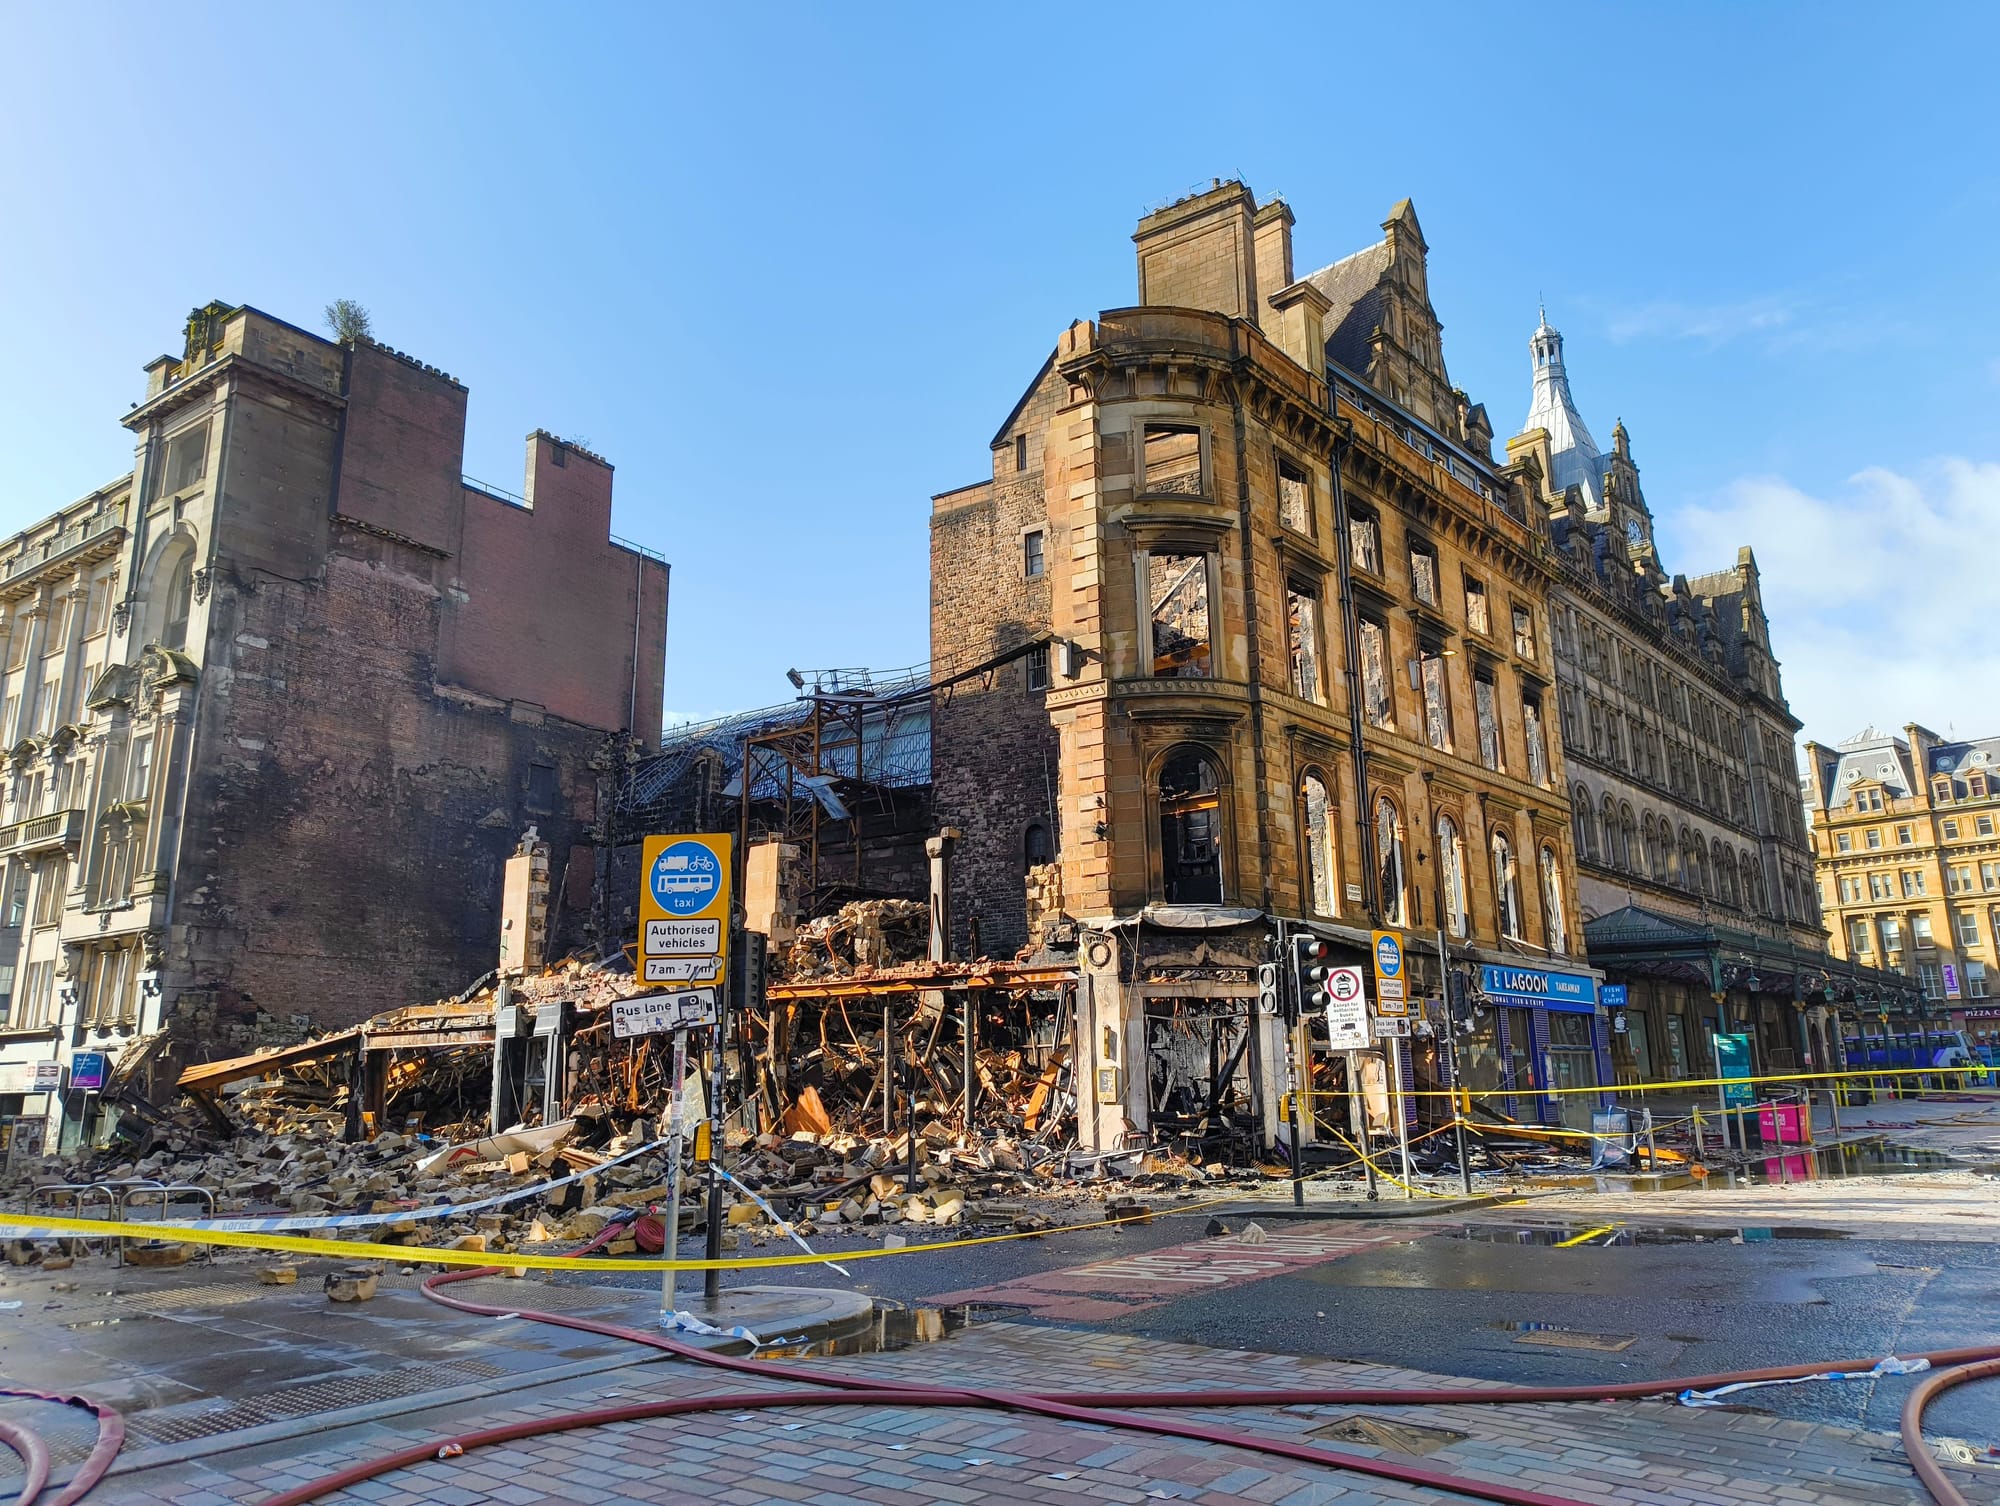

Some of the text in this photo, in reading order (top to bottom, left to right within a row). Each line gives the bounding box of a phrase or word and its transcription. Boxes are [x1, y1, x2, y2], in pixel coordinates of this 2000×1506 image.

[674, 897, 694, 908] taxi
[651, 924, 714, 936] Authorised
[658, 938, 706, 948] vehicles
[1504, 970, 1548, 992] LAGOON
[616, 1002, 672, 1016] Bus lane
